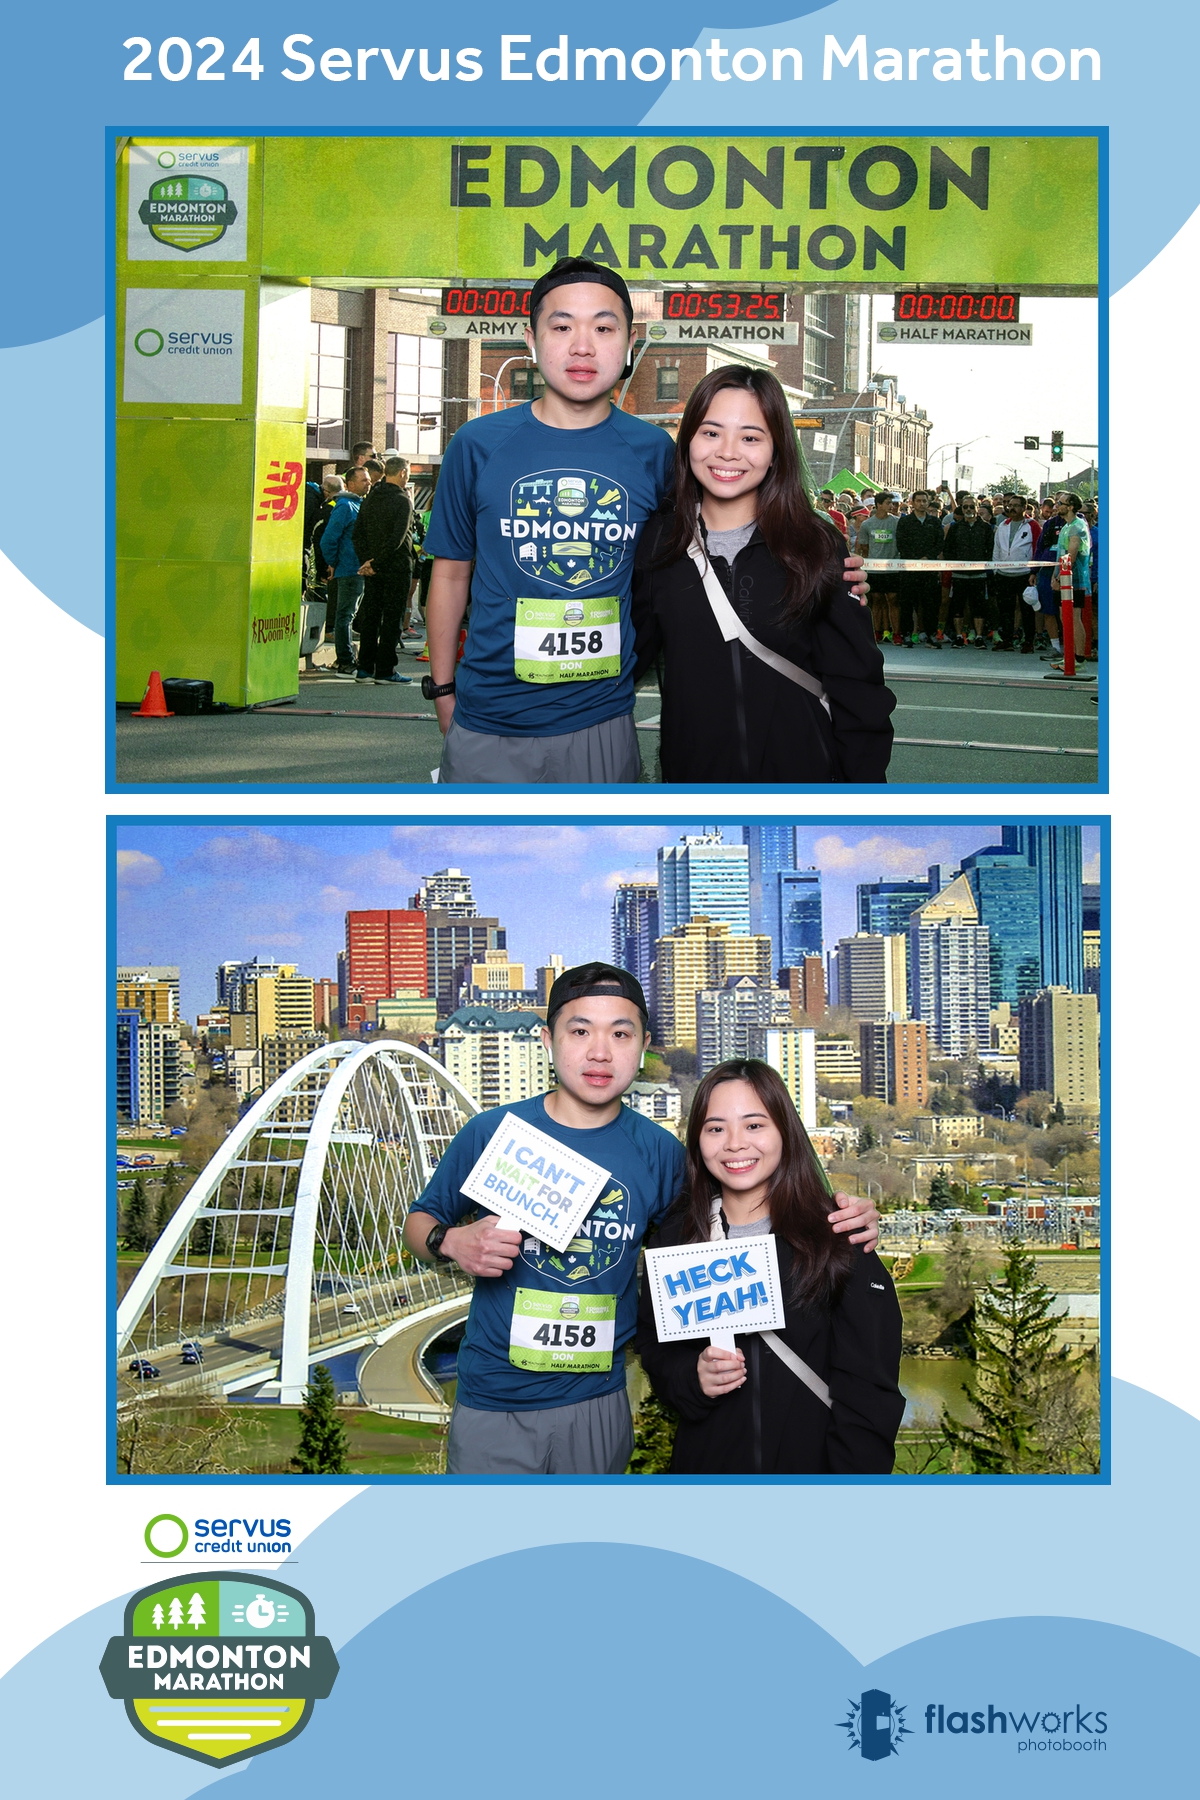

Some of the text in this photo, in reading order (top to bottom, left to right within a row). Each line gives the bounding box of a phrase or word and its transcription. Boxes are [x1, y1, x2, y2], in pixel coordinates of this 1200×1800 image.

[178, 152, 219, 161] servus
[450, 145, 990, 211] EDMONTON
[150, 203, 227, 214] EDMONTON
[523, 223, 906, 271] MARATHON
[168, 332, 233, 345] servus
[466, 321, 517, 335] ARMY
[679, 325, 785, 340] MARATHON
[900, 328, 939, 339] HALF
[943, 329, 1031, 341] MARATHON
[167, 346, 232, 355] credit union
[500, 518, 637, 541] EDMONTON
[257, 613, 290, 643] Running
[538, 630, 603, 656] 4158
[560, 662, 582, 670] DON
[576, 669, 609, 677] MARATHON
[503, 1139, 586, 1195] I CAN'T
[494, 1157, 573, 1214] WAIT FOR
[483, 1173, 560, 1229] BRUNCH.
[576, 1220, 636, 1242] NTON
[663, 1251, 757, 1299] HECK
[672, 1281, 769, 1329] YEAH!
[533, 1323, 596, 1347] 4158
